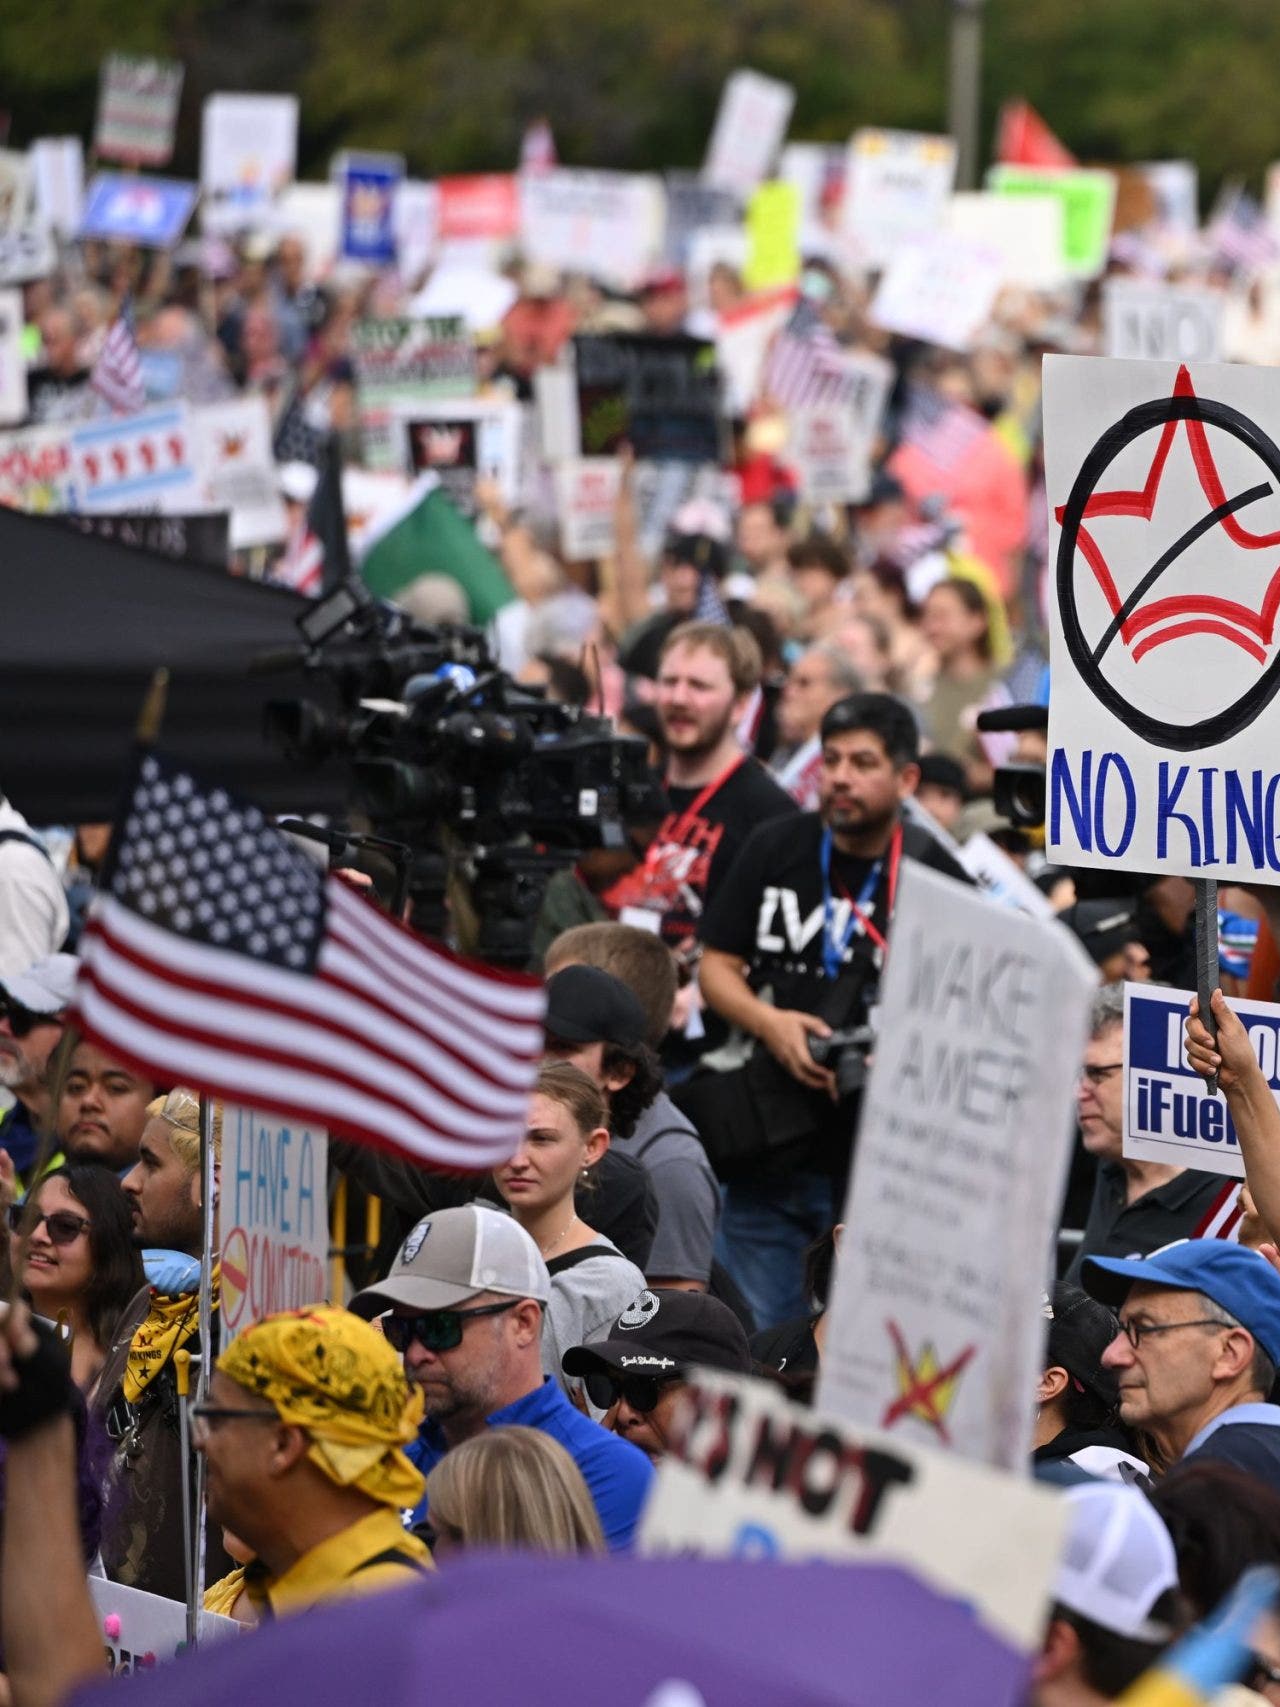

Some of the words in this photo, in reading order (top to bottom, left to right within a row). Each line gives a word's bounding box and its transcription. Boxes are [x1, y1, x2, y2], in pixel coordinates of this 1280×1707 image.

[1050, 748, 1137, 857] NO
[234, 1107, 291, 1233] HAVE
[297, 1130, 315, 1242] A
[138, 1350, 162, 1360] KINGS
[745, 1413, 918, 1537] NOT
